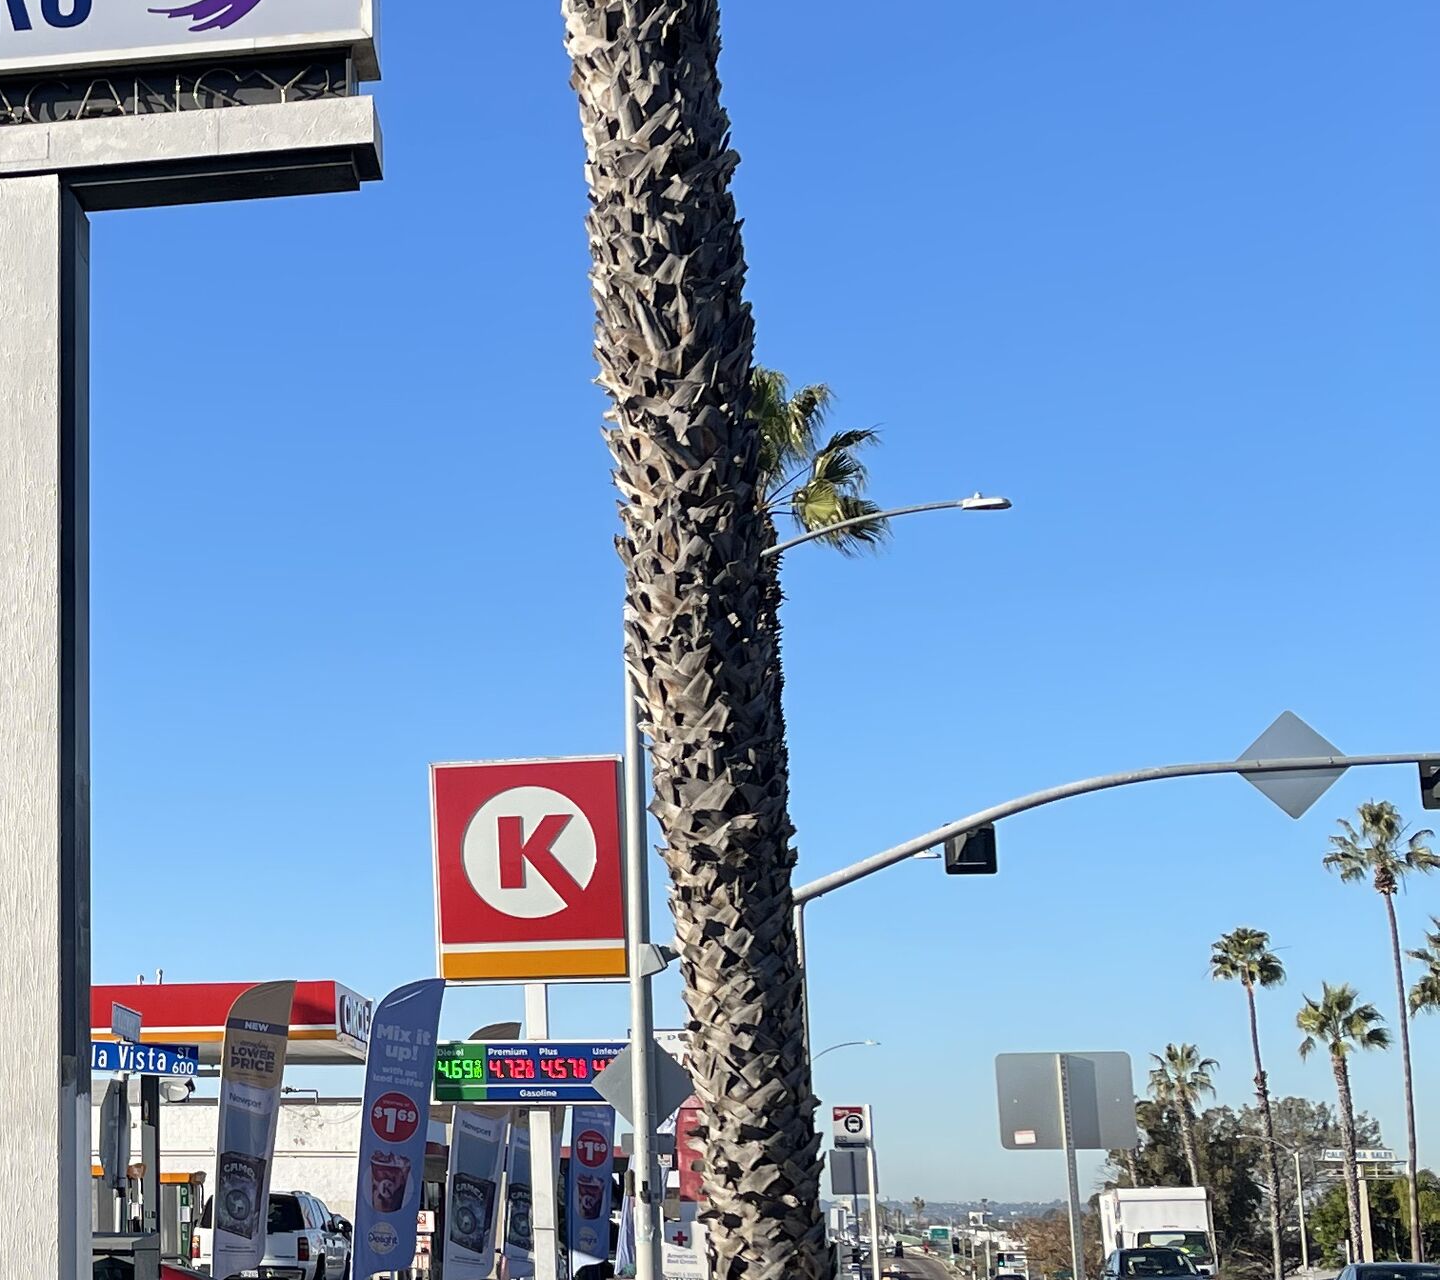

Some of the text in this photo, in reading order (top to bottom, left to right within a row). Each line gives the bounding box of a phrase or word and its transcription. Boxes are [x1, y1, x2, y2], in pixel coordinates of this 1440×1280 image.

[497, 814, 588, 908] K
[244, 1020, 269, 1033] NEW
[376, 1023, 432, 1046] Mix it
[91, 1045, 191, 1072] la Vista ST
[231, 1045, 275, 1061] LOWER
[385, 1044, 420, 1062] up!
[437, 1047, 465, 1057] Diesel
[488, 1047, 528, 1056] Premium
[538, 1047, 558, 1056] Plus
[592, 1047, 626, 1056] Unlead
[172, 1061, 194, 1075] 600
[230, 1056, 275, 1074] PRICE
[382, 1066, 403, 1077] with
[394, 1076, 424, 1088] coffee
[229, 1092, 262, 1108] Newport
[519, 1089, 557, 1098] Gasoline
[461, 1120, 492, 1137] Newport
[223, 1163, 256, 1183] CAMEL
[456, 1183, 484, 1201] CAMEL
